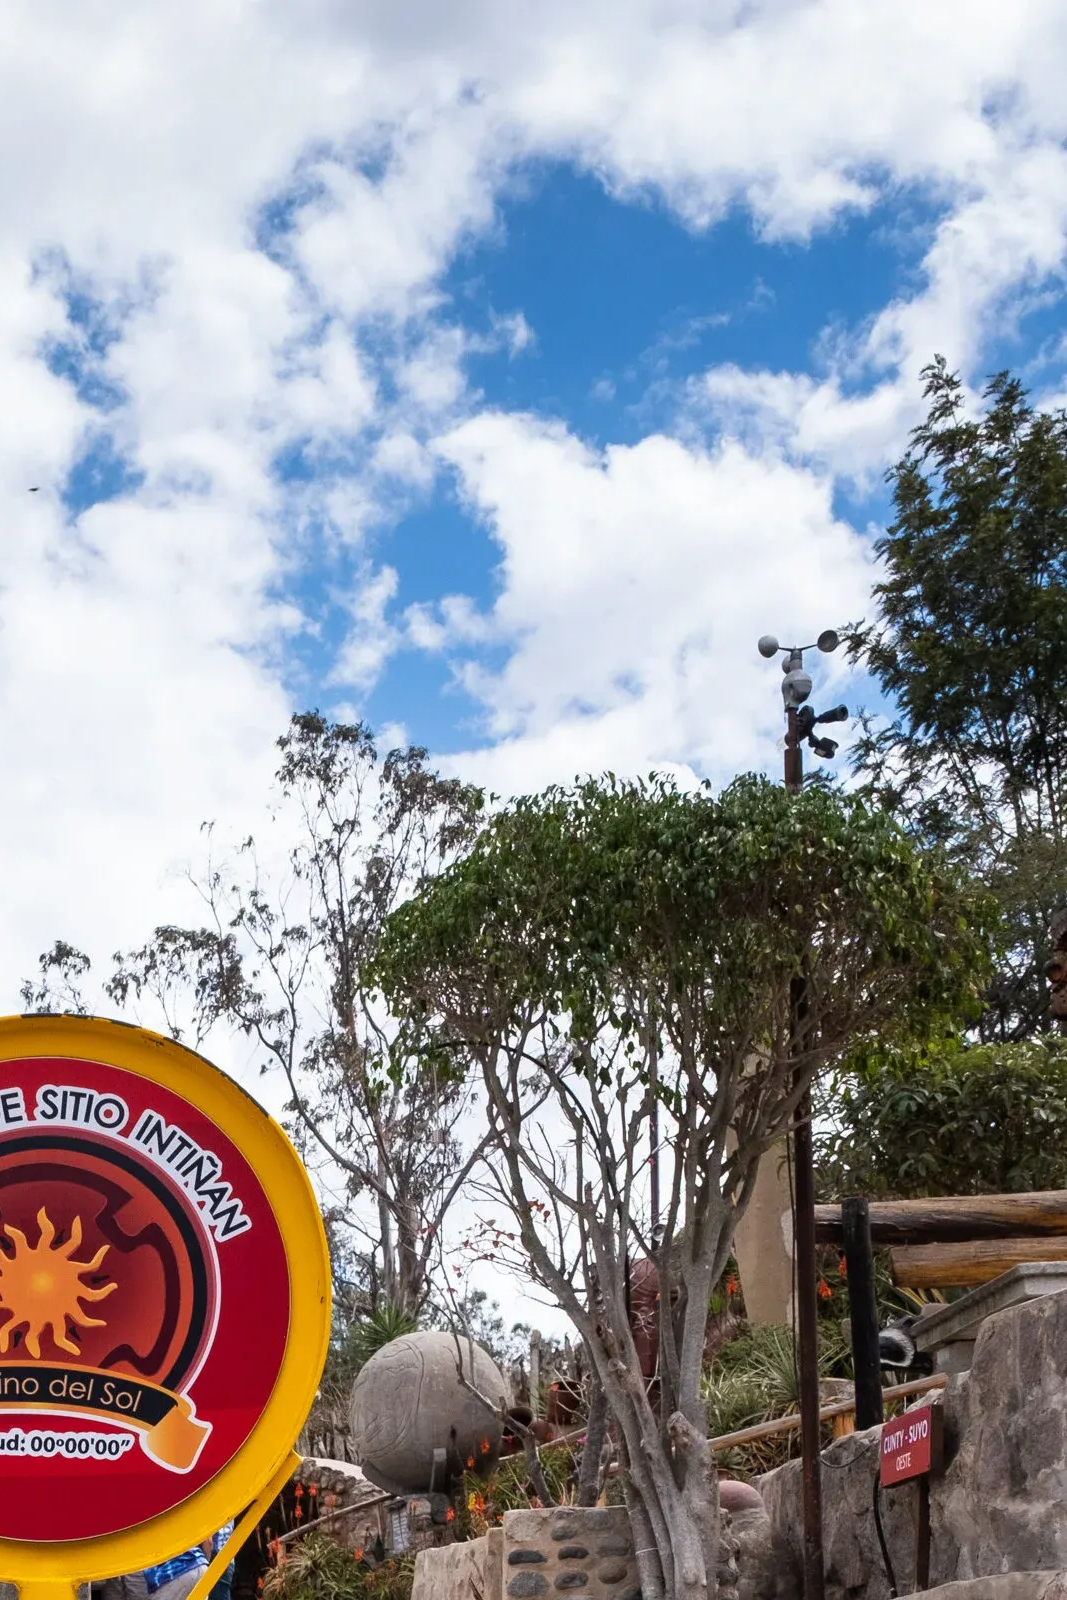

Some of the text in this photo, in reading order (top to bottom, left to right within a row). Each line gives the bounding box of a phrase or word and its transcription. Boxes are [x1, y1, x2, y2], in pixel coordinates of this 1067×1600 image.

[39, 1089, 126, 1129] SITIO
[135, 1114, 248, 1237] INTIÑAN
[49, 1374, 95, 1401] del
[100, 1381, 143, 1413] Sol
[883, 1429, 905, 1454] CUNTY
[909, 1420, 927, 1443] SUYO
[896, 1452, 910, 1471] OESTE
